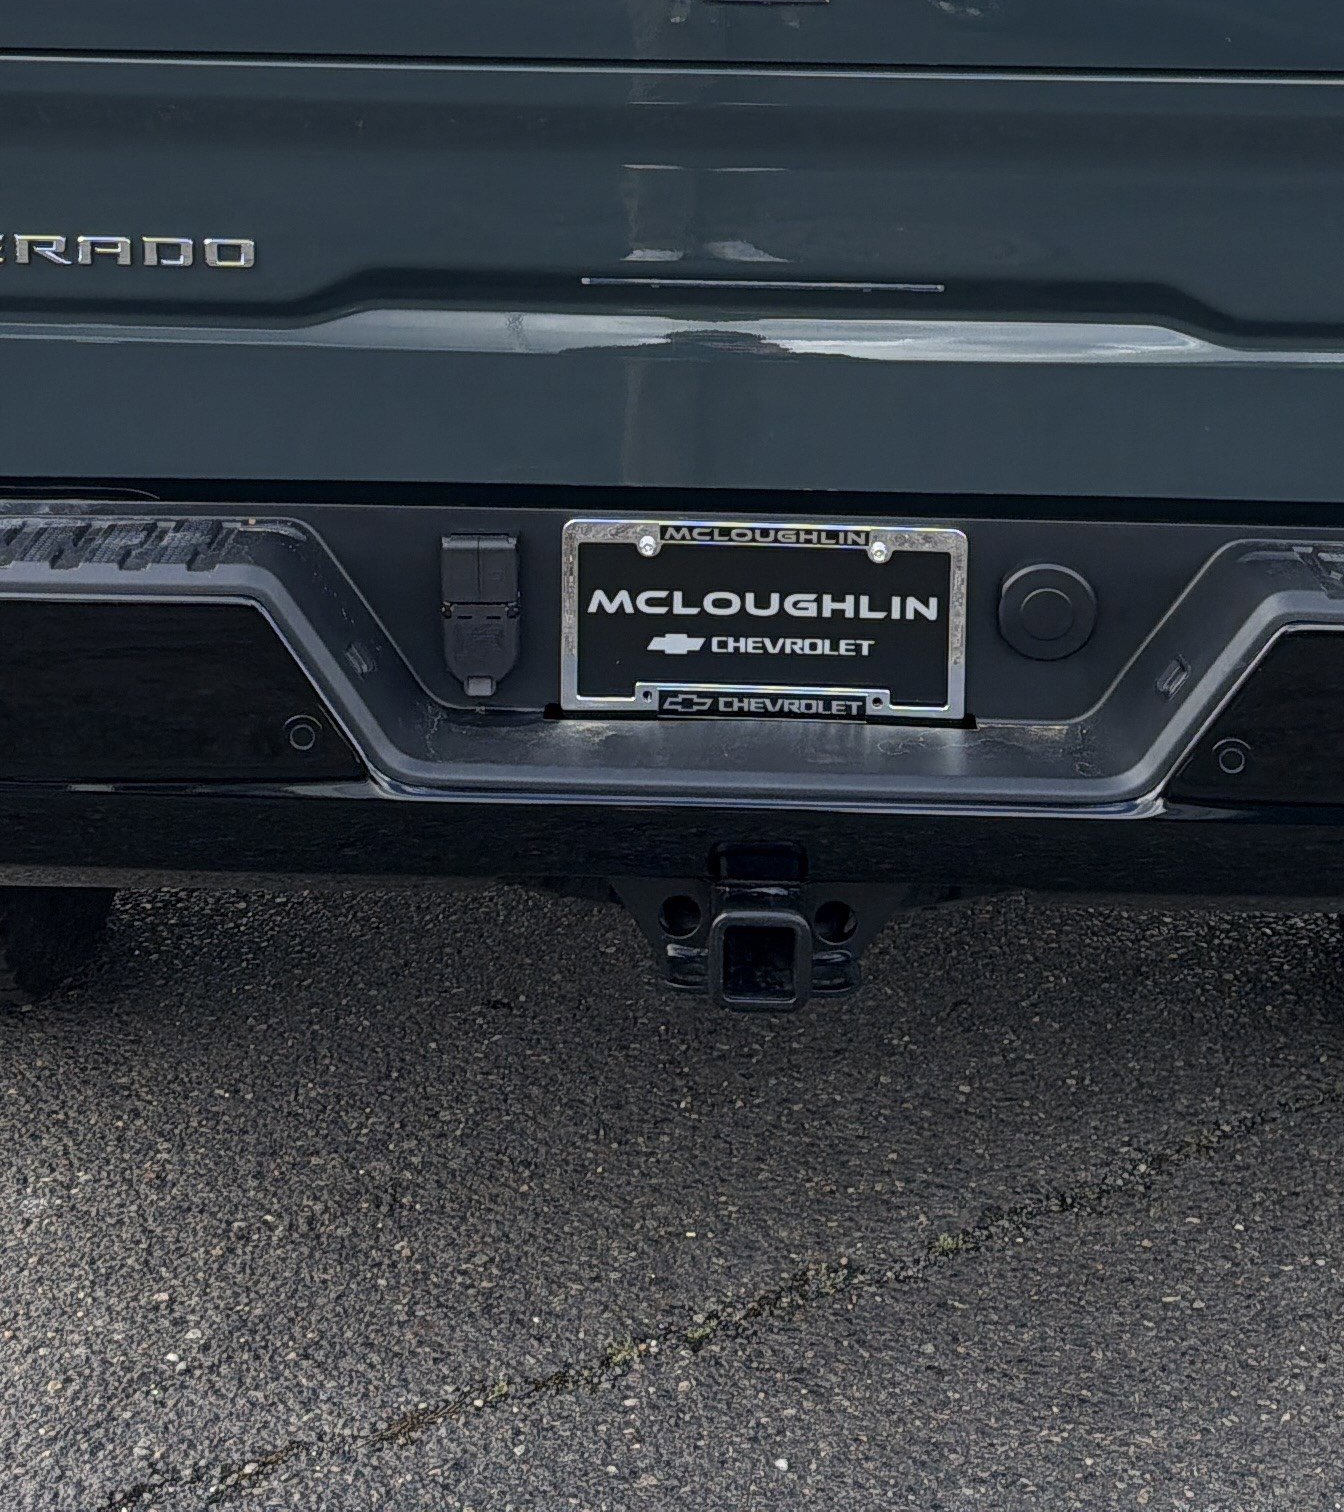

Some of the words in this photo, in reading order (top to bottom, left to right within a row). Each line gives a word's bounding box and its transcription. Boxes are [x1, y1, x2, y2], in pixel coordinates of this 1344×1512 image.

[664, 526, 867, 546] MCLOUGHLIN
[587, 589, 938, 621] MCLOUGHLIN
[711, 637, 875, 656] CHEVROLET
[718, 696, 863, 716] CHEVROLET
